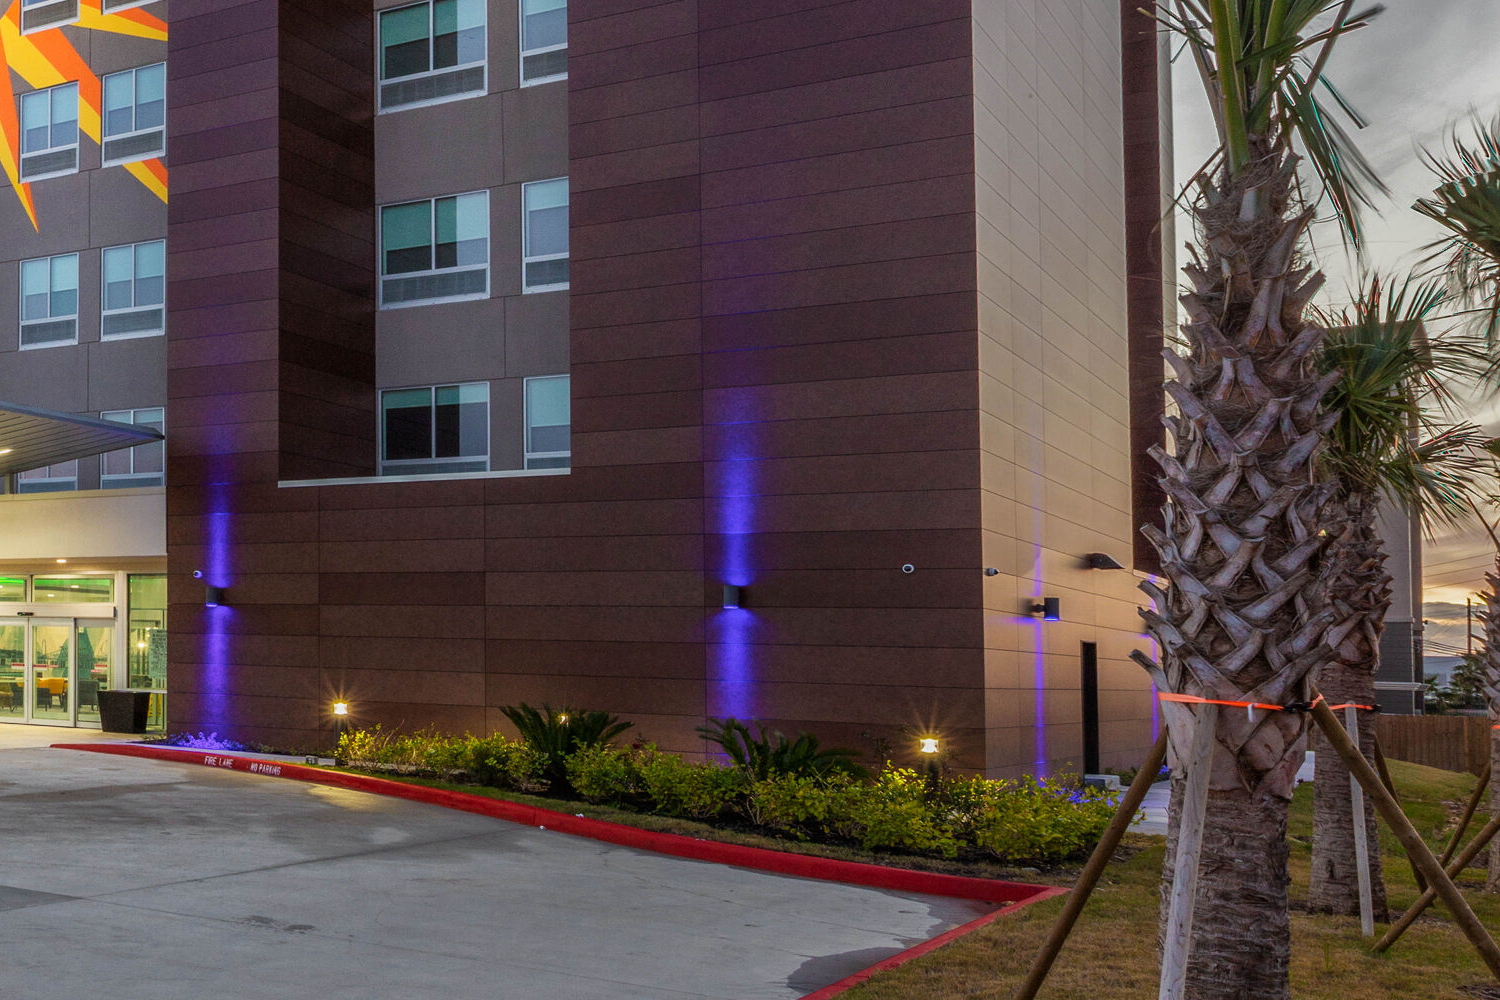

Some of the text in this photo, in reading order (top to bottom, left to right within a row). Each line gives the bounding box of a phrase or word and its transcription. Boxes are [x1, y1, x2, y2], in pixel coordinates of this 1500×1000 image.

[204, 755, 282, 776] FIRE LANE NO PARKING
